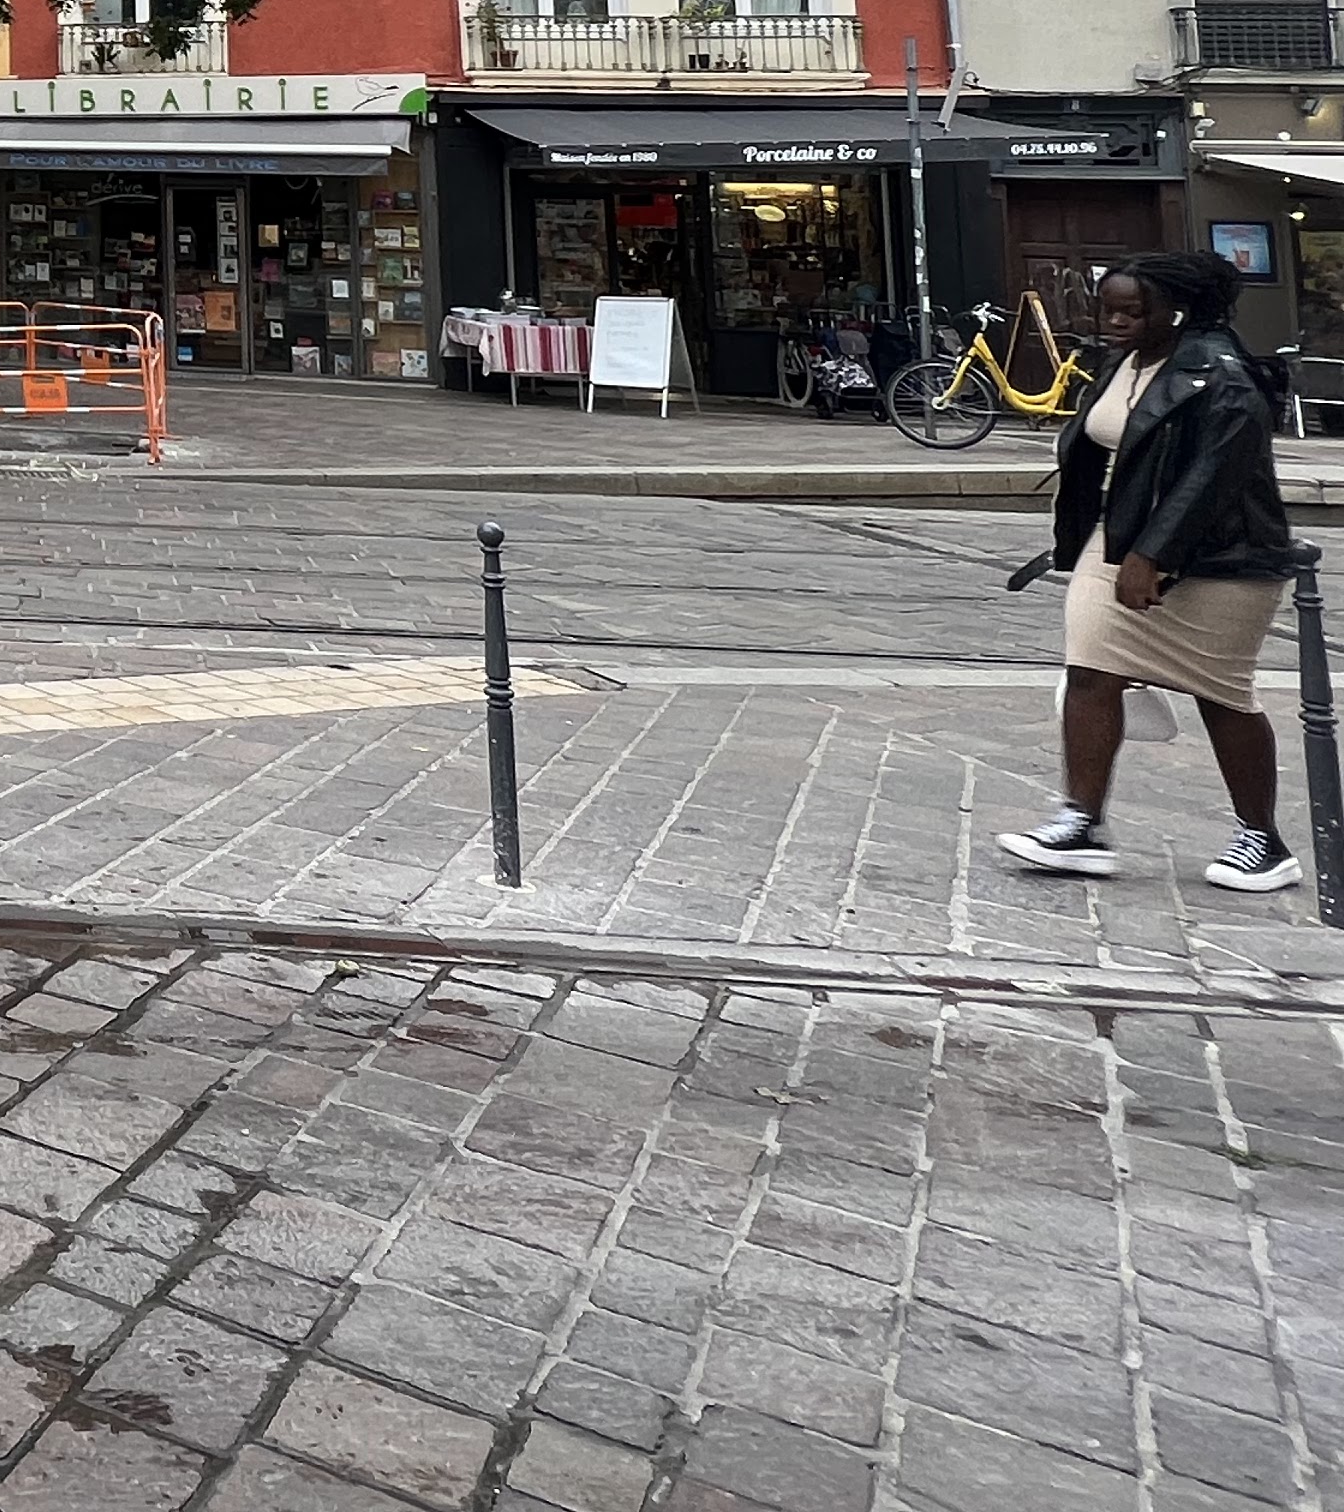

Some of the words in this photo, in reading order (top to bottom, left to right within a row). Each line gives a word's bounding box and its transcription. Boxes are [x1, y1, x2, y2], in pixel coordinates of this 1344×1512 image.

[742, 145, 834, 163] Porcelaine
[837, 144, 853, 160] &
[856, 148, 878, 160] co
[215, 158, 280, 171] LIVRE
